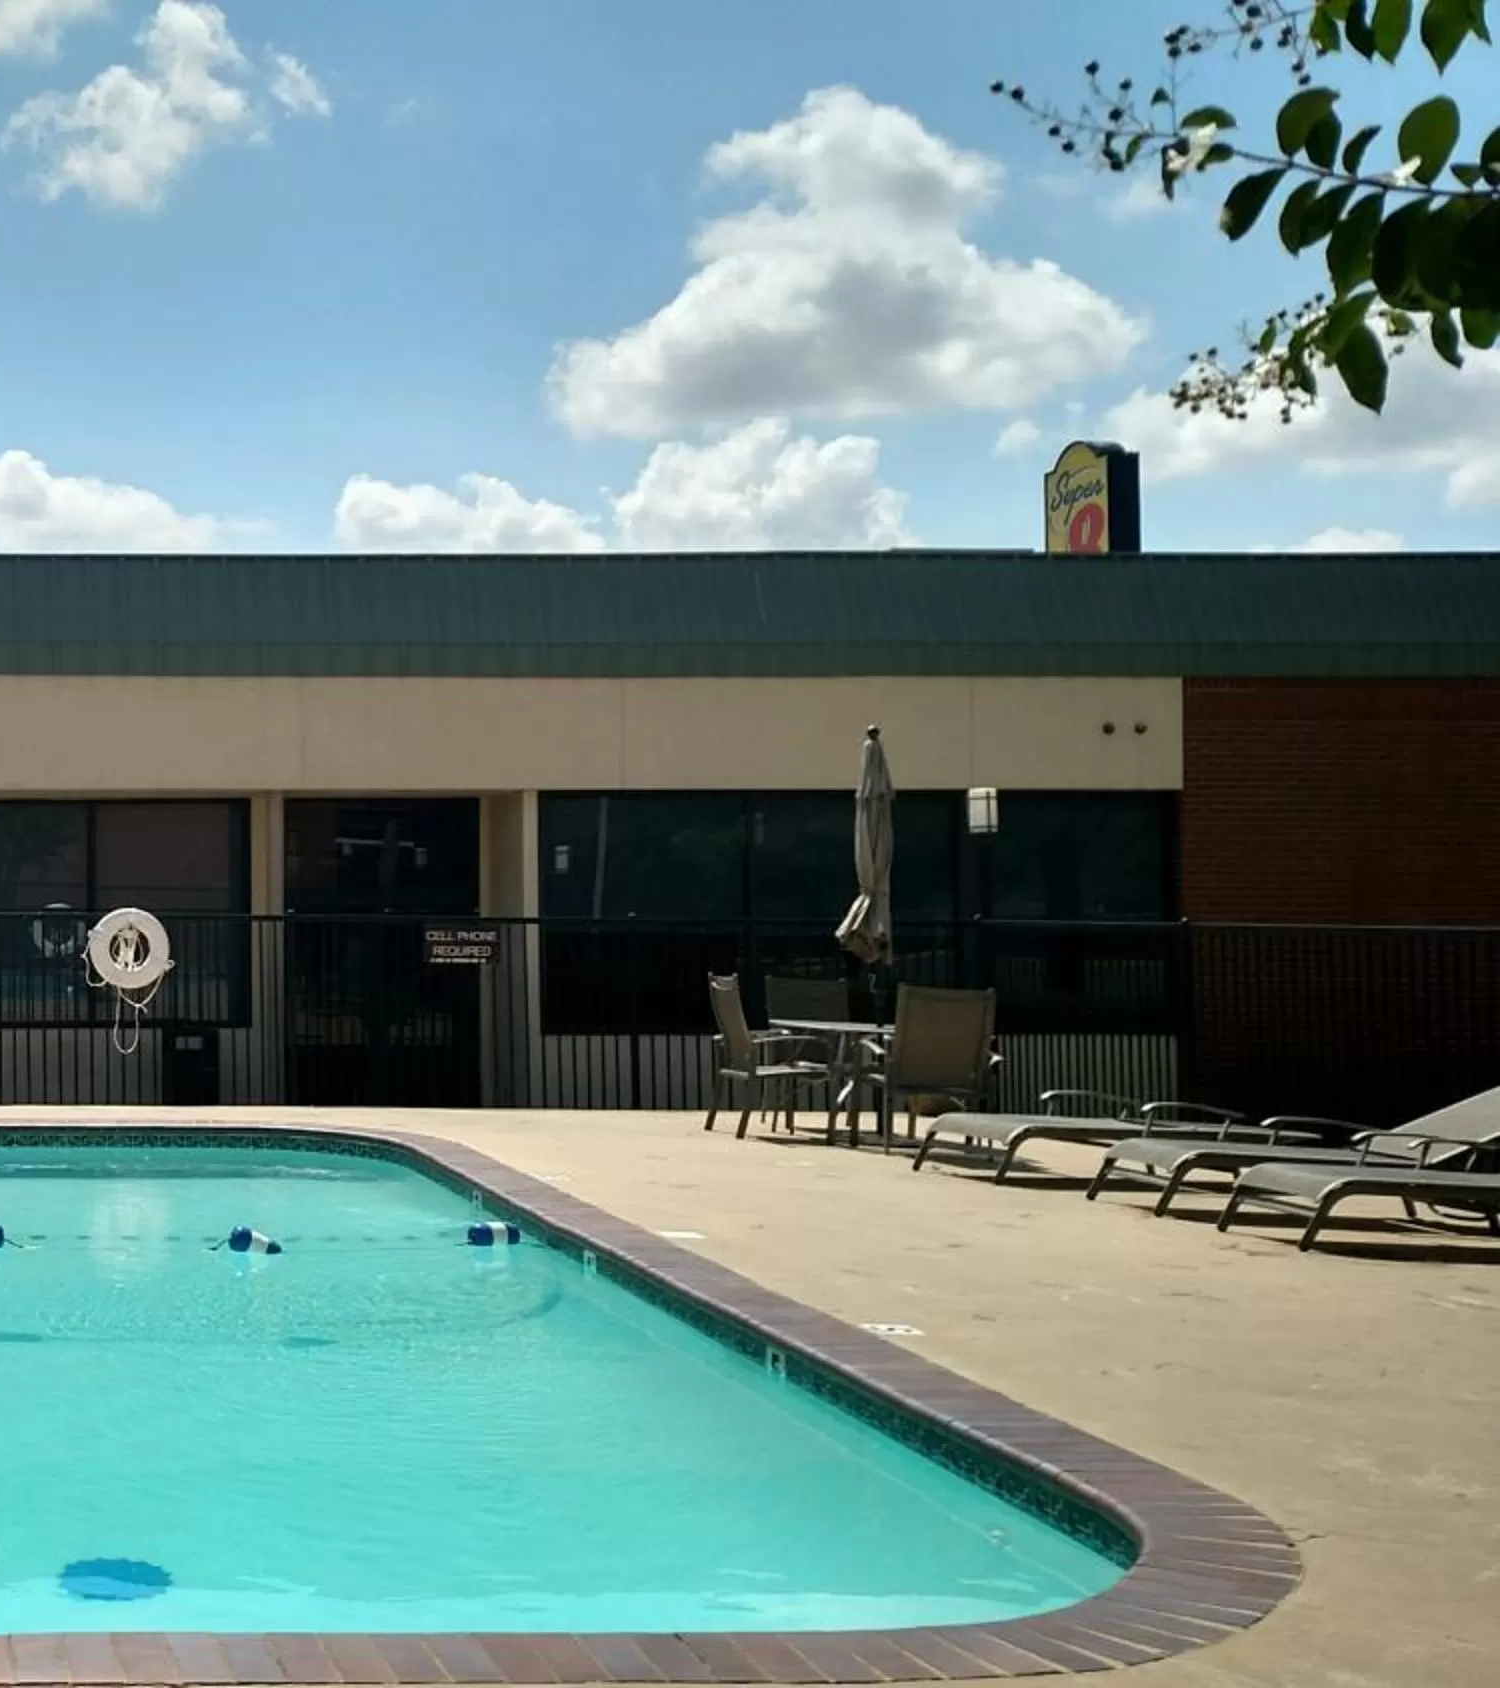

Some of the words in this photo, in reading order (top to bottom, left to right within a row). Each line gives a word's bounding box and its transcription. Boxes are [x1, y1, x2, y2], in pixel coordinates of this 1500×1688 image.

[1051, 465, 1104, 525] Super
[425, 930, 456, 941] CELL
[457, 930, 497, 941] PHONE
[432, 945, 492, 957] REQUIRED
